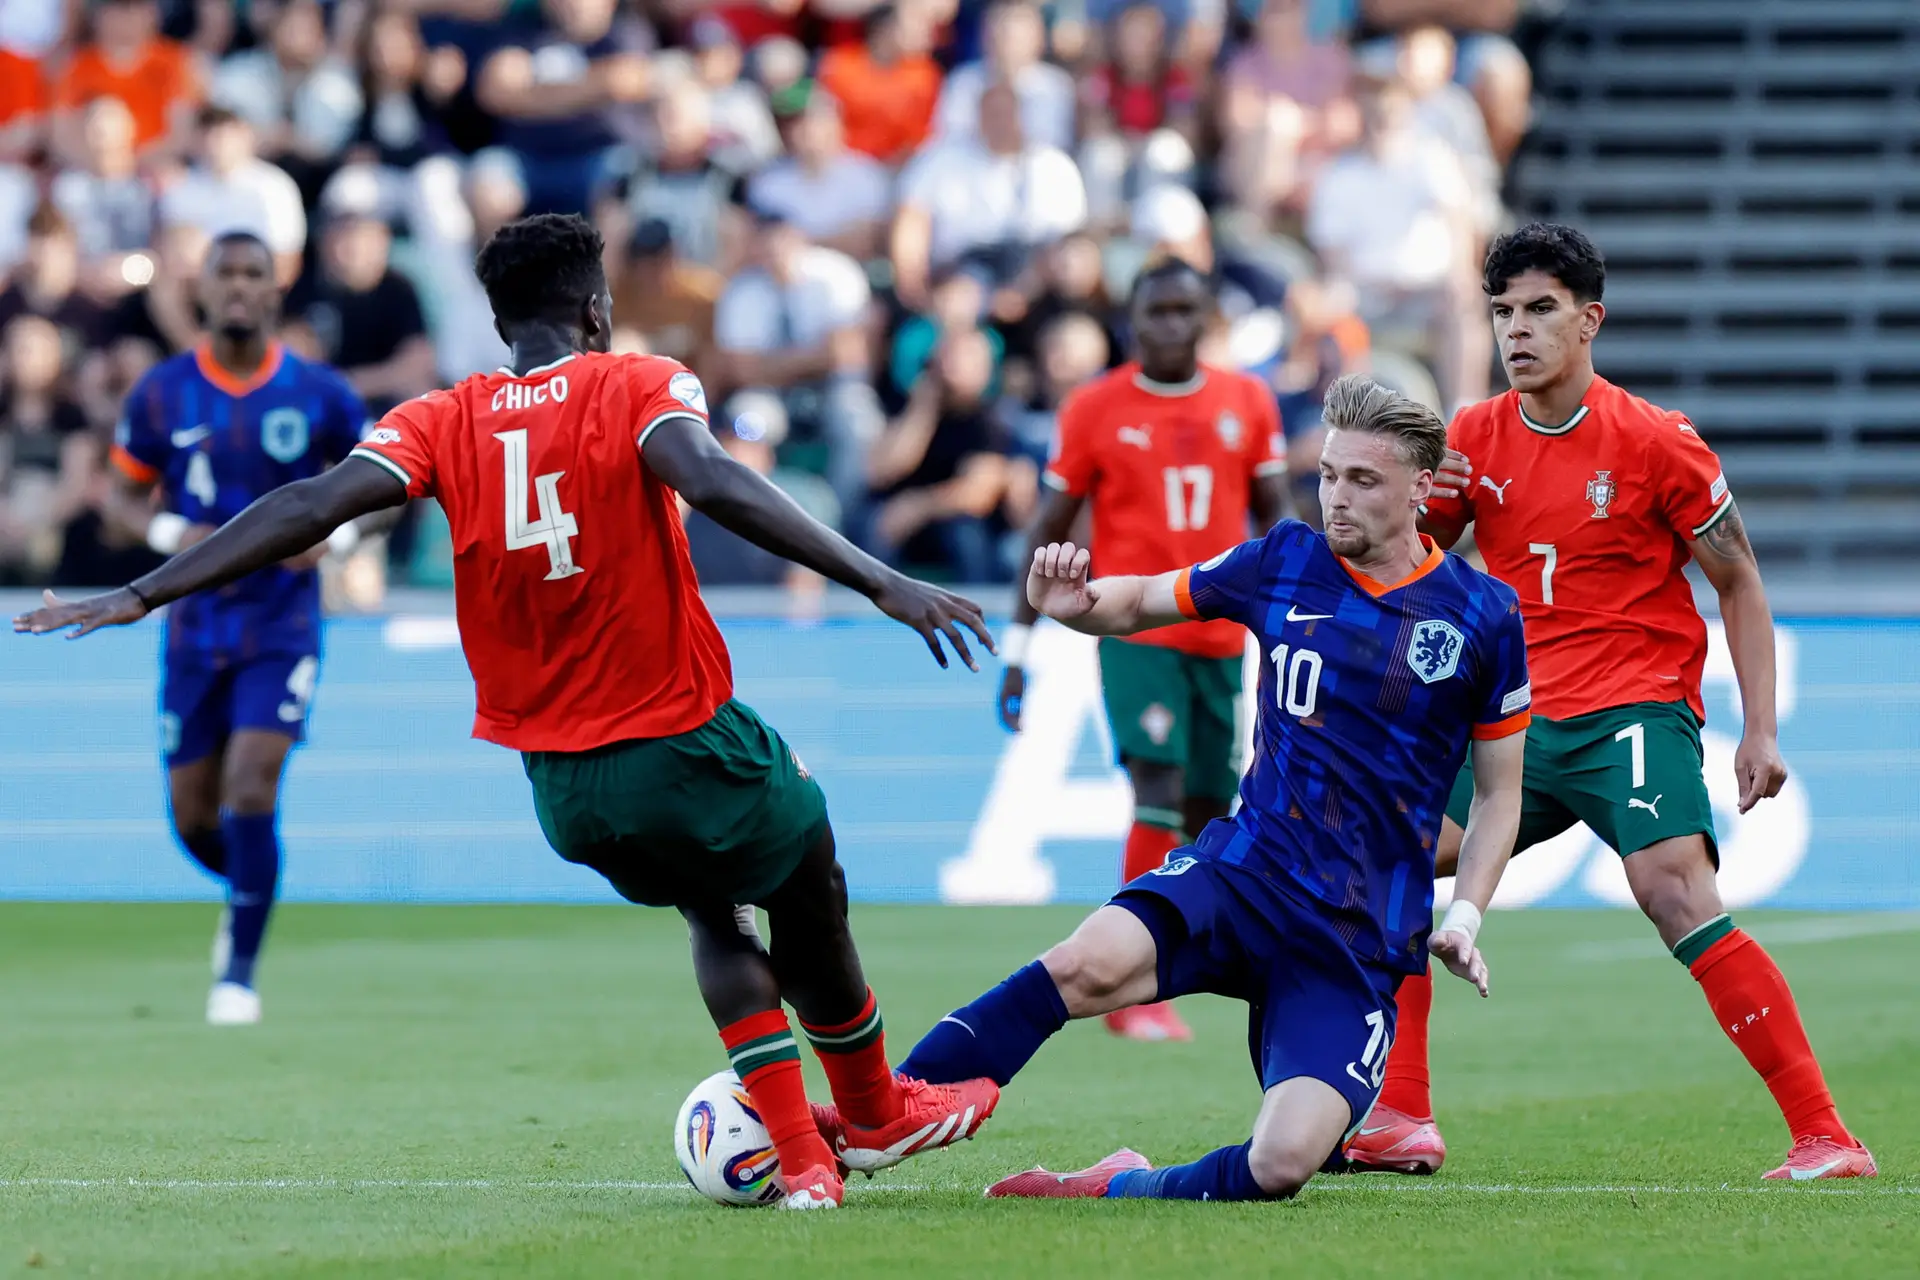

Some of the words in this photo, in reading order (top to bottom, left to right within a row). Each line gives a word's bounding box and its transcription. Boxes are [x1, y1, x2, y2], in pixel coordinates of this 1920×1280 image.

[491, 375, 569, 412] CHICO
[493, 428, 584, 581] 4
[1163, 464, 1213, 532] 17
[1528, 542, 1557, 606] 7
[1270, 643, 1323, 717] 10
